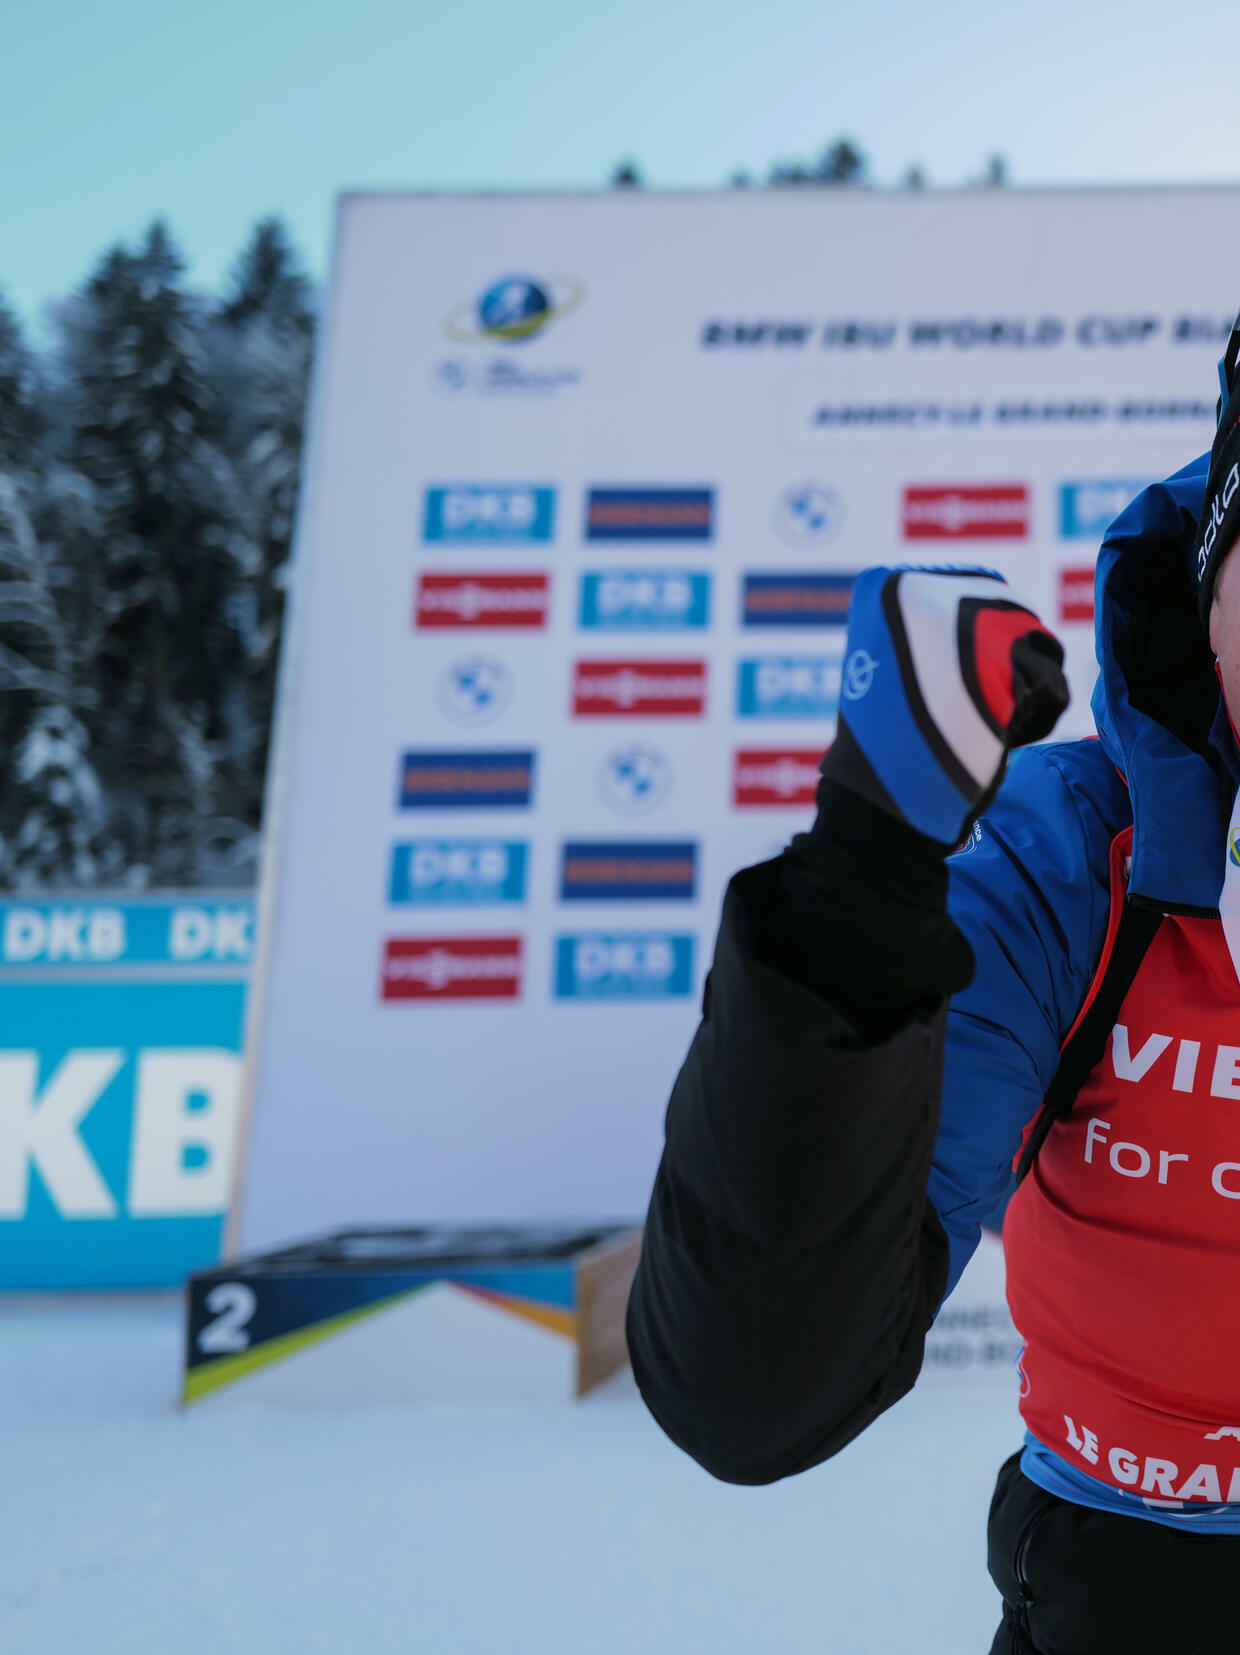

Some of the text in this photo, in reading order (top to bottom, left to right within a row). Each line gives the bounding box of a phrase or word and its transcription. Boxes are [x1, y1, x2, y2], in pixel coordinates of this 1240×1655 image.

[909, 316, 1064, 347] WORLD
[1077, 316, 1160, 345] CUP
[409, 848, 507, 887] DKB
[4, 908, 254, 962] DKB DK
[573, 942, 676, 982] DKB
[0, 1046, 243, 1221] KB
[1084, 1117, 1189, 1185] for
[200, 1285, 256, 1353] 2
[1063, 1414, 1099, 1466] LE
